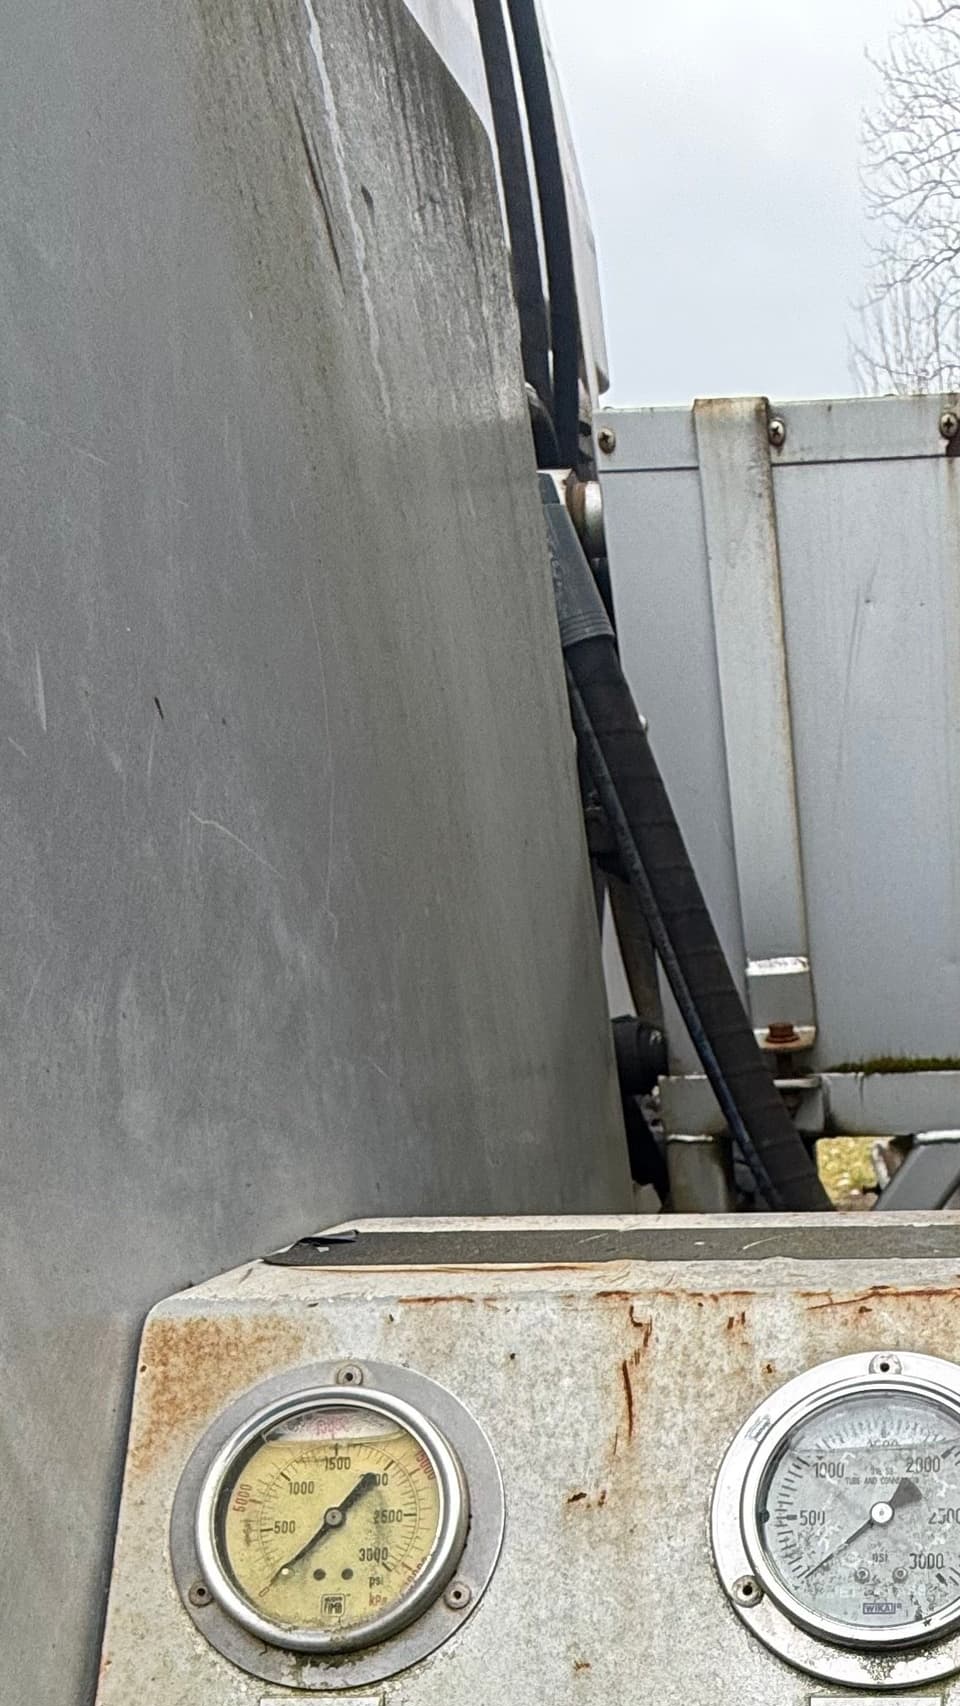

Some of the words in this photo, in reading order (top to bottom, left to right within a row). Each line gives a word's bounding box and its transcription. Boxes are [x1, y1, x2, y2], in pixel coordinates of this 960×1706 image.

[325, 1456, 351, 1471] 1500
[813, 1462, 845, 1478] 1000
[906, 1456, 941, 1473] 2000
[360, 1472, 388, 1486] 00
[288, 1481, 315, 1495] 1000
[232, 1483, 253, 1512] 5000
[374, 1510, 403, 1524] 2500
[800, 1510, 825, 1526] 500
[274, 1520, 296, 1534] 500
[359, 1547, 388, 1562] 3000
[909, 1552, 944, 1570] 3000
[864, 1603, 895, 1614] WIKA
